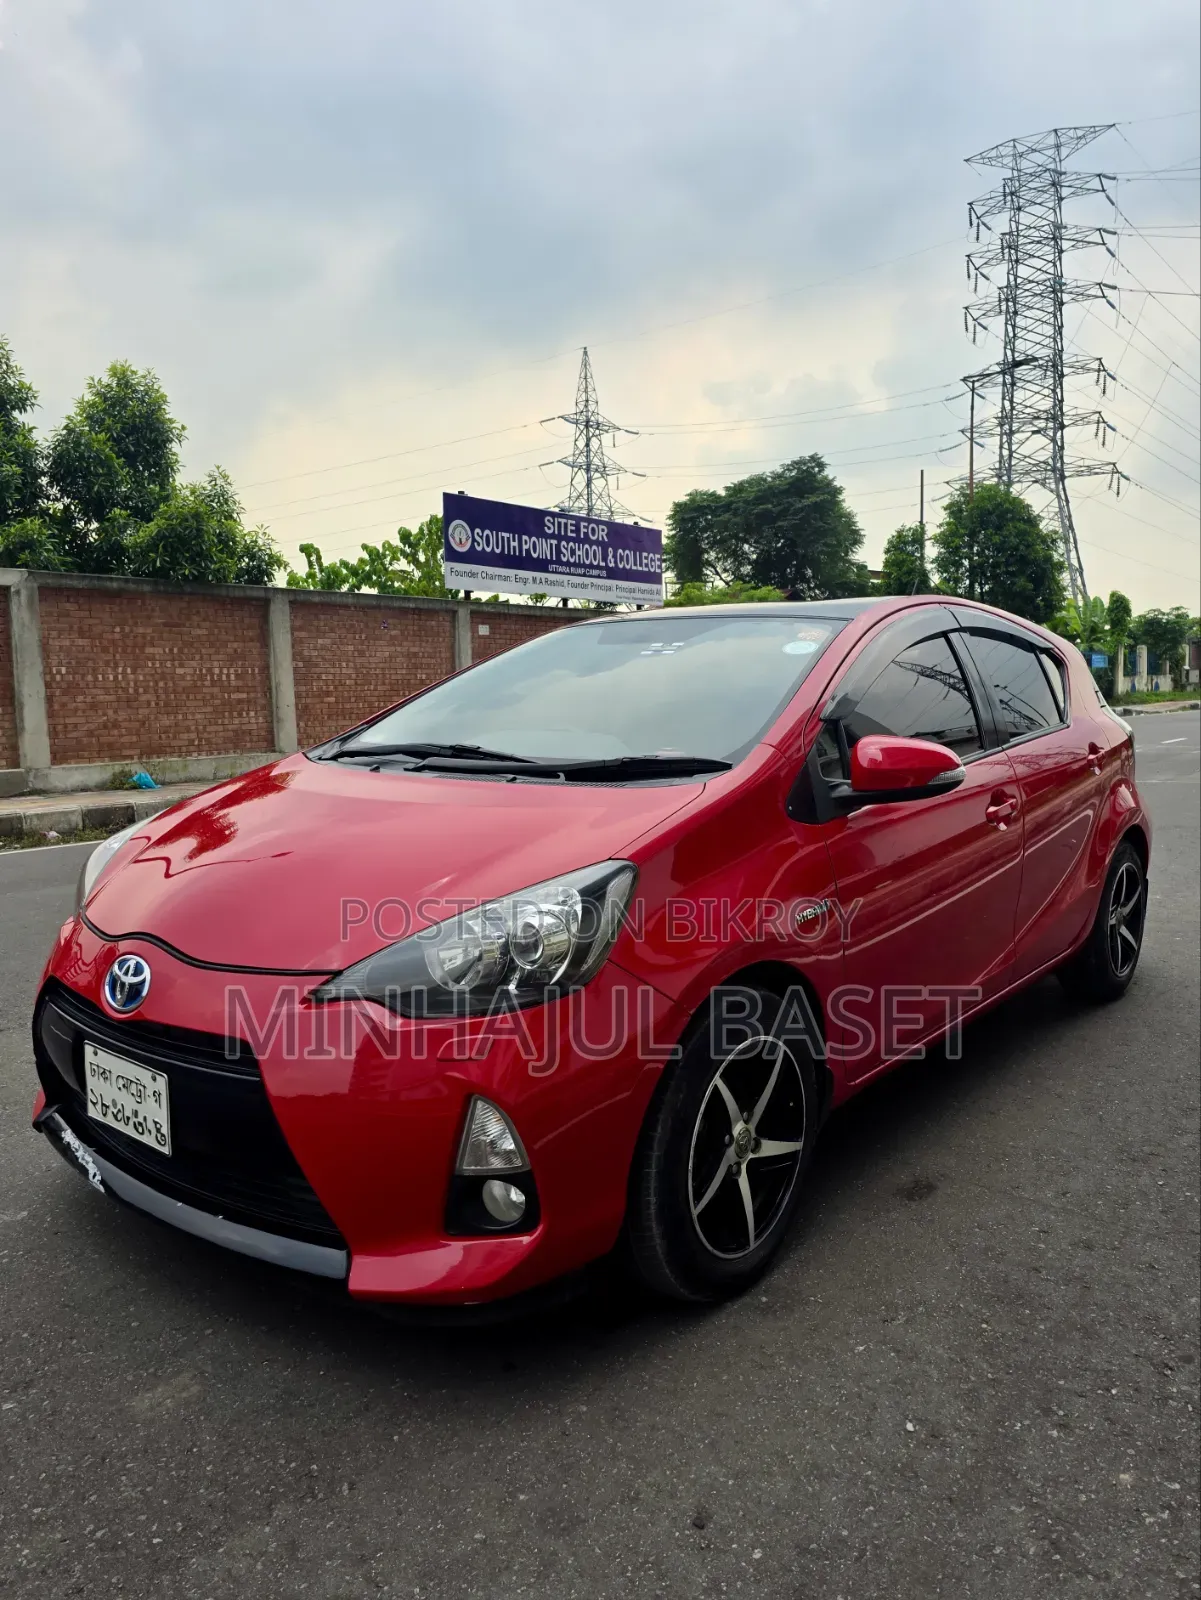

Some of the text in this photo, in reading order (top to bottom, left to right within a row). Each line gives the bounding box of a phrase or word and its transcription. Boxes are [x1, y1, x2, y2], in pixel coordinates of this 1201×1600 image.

[544, 516, 608, 541] SITE FOR
[474, 528, 661, 573] SOUTH POINT SCHOOL & COLLEGE
[450, 567, 479, 579] Founder
[481, 571, 512, 582] Chairman:
[514, 574, 530, 585] Engr.
[544, 578, 566, 590] Rashid,
[567, 580, 589, 590] Founder
[590, 582, 614, 592] Principal:
[616, 584, 636, 594] Principal
[548, 564, 570, 573] UTTARA
[586, 568, 607, 577] CAMPUS
[89, 1061, 113, 1088] ঢাকা
